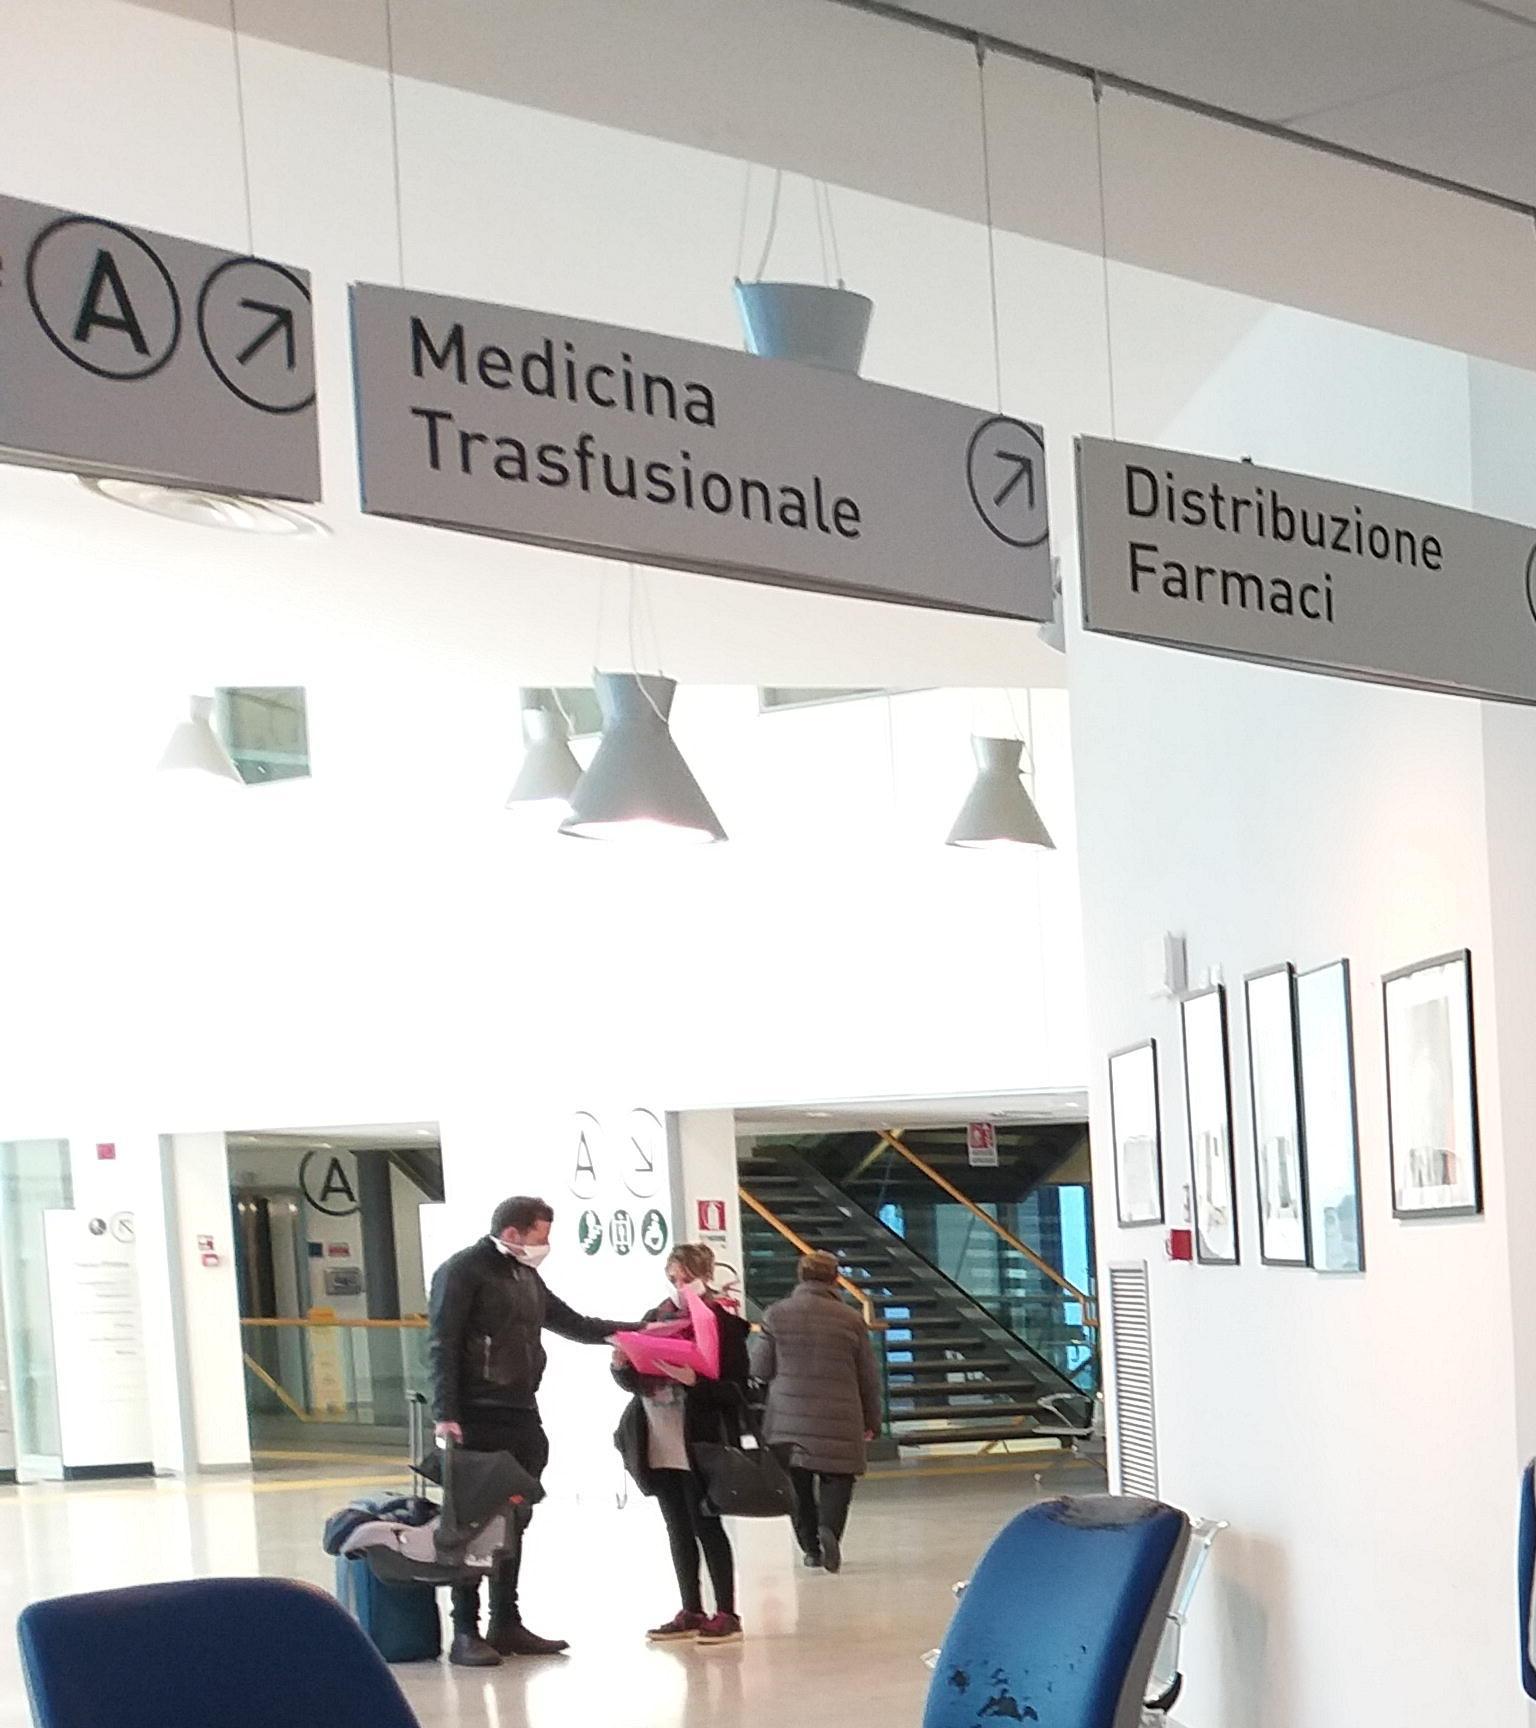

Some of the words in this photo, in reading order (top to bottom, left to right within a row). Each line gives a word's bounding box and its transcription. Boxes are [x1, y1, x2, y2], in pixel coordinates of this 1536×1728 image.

[73, 248, 151, 357] A
[409, 316, 718, 430] Medicina
[410, 406, 863, 540] Trasfusionale
[1124, 463, 1444, 572] Distribuzione
[1128, 541, 1335, 624] Farmaci
[319, 1156, 357, 1202] A
[574, 1129, 597, 1183] A
